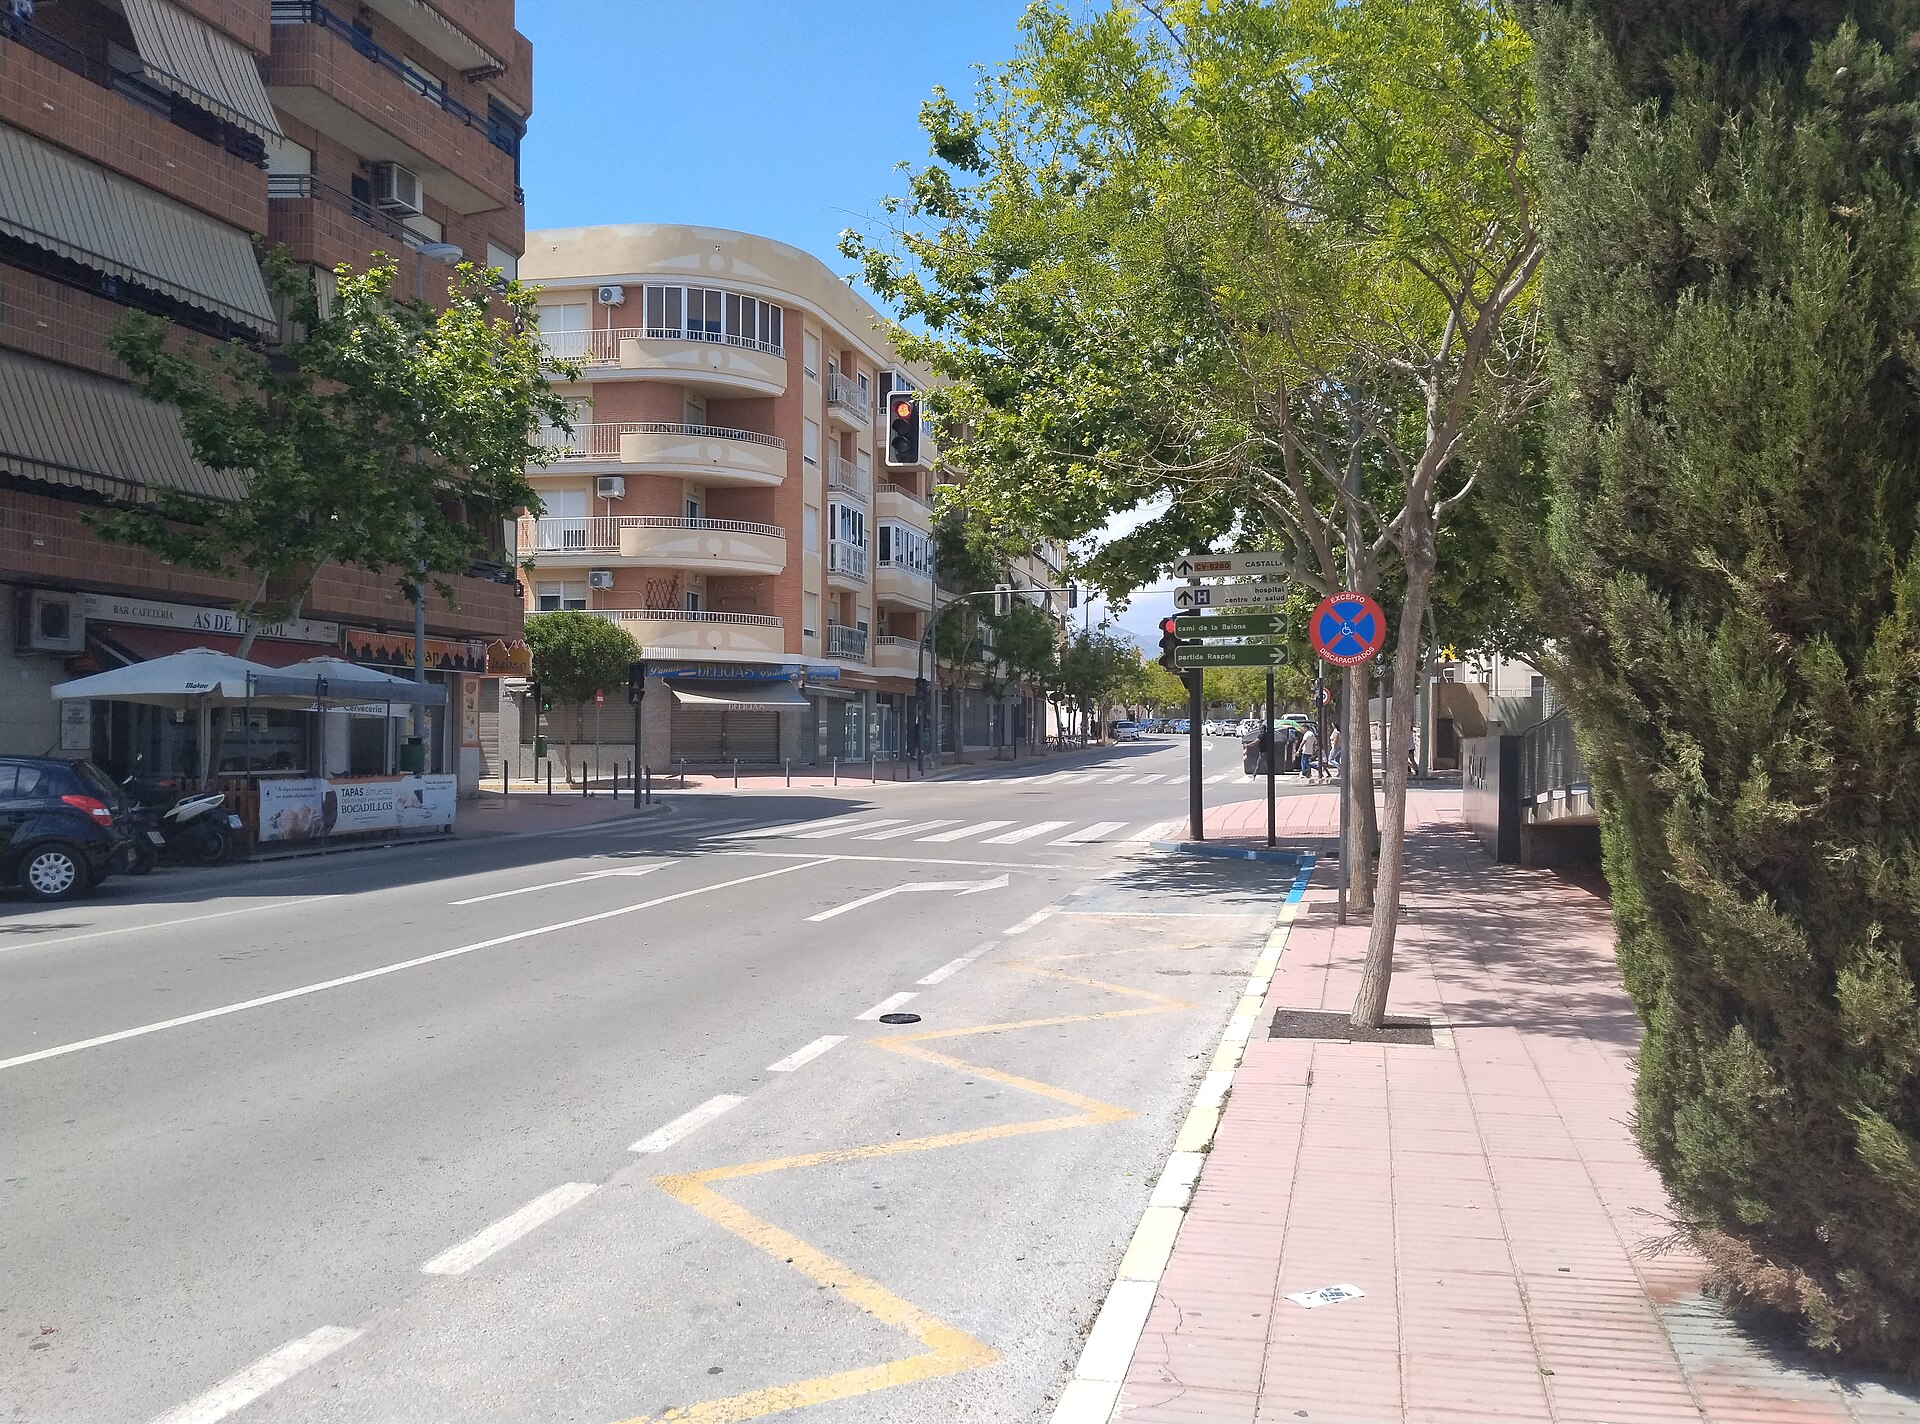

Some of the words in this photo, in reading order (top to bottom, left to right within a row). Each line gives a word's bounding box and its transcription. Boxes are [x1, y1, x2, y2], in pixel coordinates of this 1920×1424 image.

[1195, 562, 1230, 571] CV-8280
[1254, 586, 1285, 594] hospital
[1224, 596, 1248, 604] centro
[1330, 593, 1365, 604] EXCEPTO
[113, 605, 129, 615] BAR
[193, 612, 211, 629] AS
[214, 614, 232, 631] DE
[1178, 653, 1204, 661] partida
[1319, 646, 1375, 664] DISCAPACITADOS
[341, 787, 364, 798] TAPAS
[341, 801, 393, 814] BOCADILLOS
